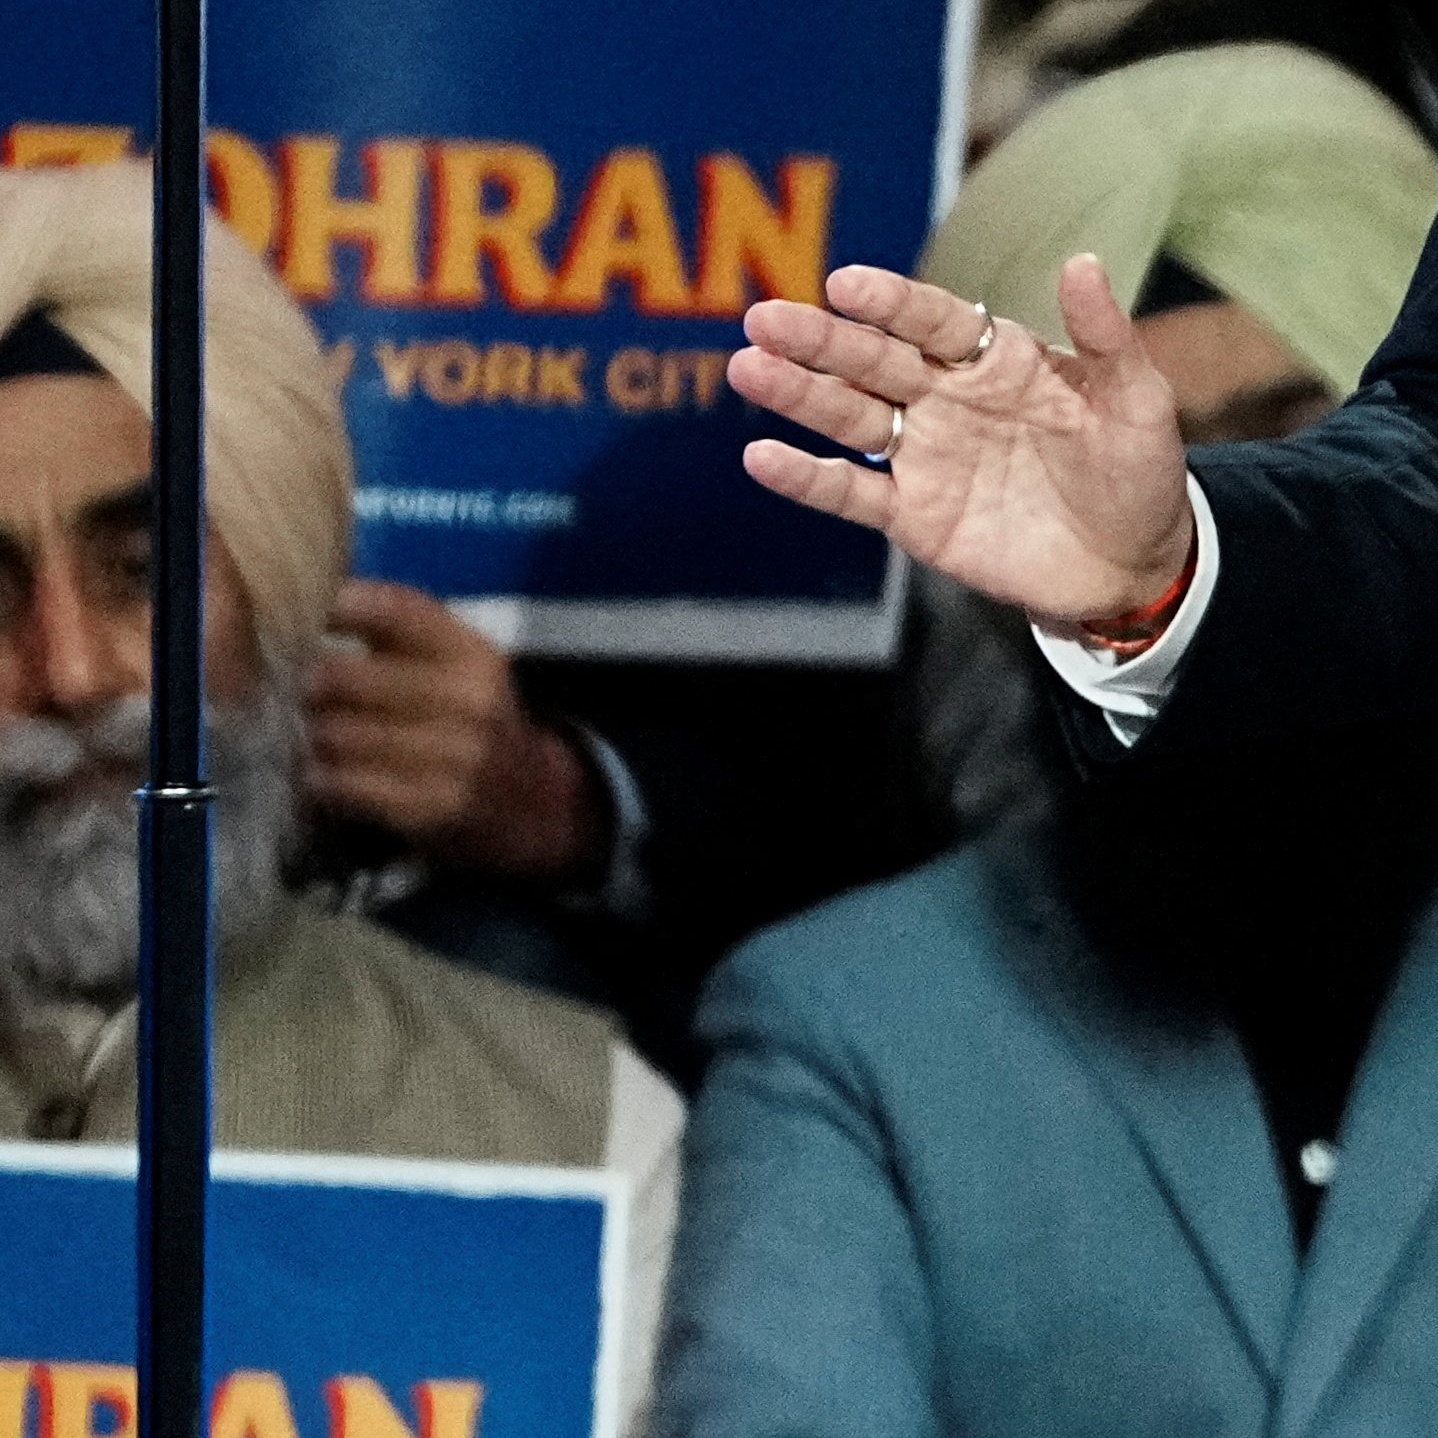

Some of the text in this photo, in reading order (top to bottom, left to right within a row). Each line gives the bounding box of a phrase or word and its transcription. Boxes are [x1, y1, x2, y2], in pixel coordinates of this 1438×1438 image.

[4, 120, 840, 318] HRAN
[375, 340, 588, 406] YORK
[606, 346, 745, 414] CIT
